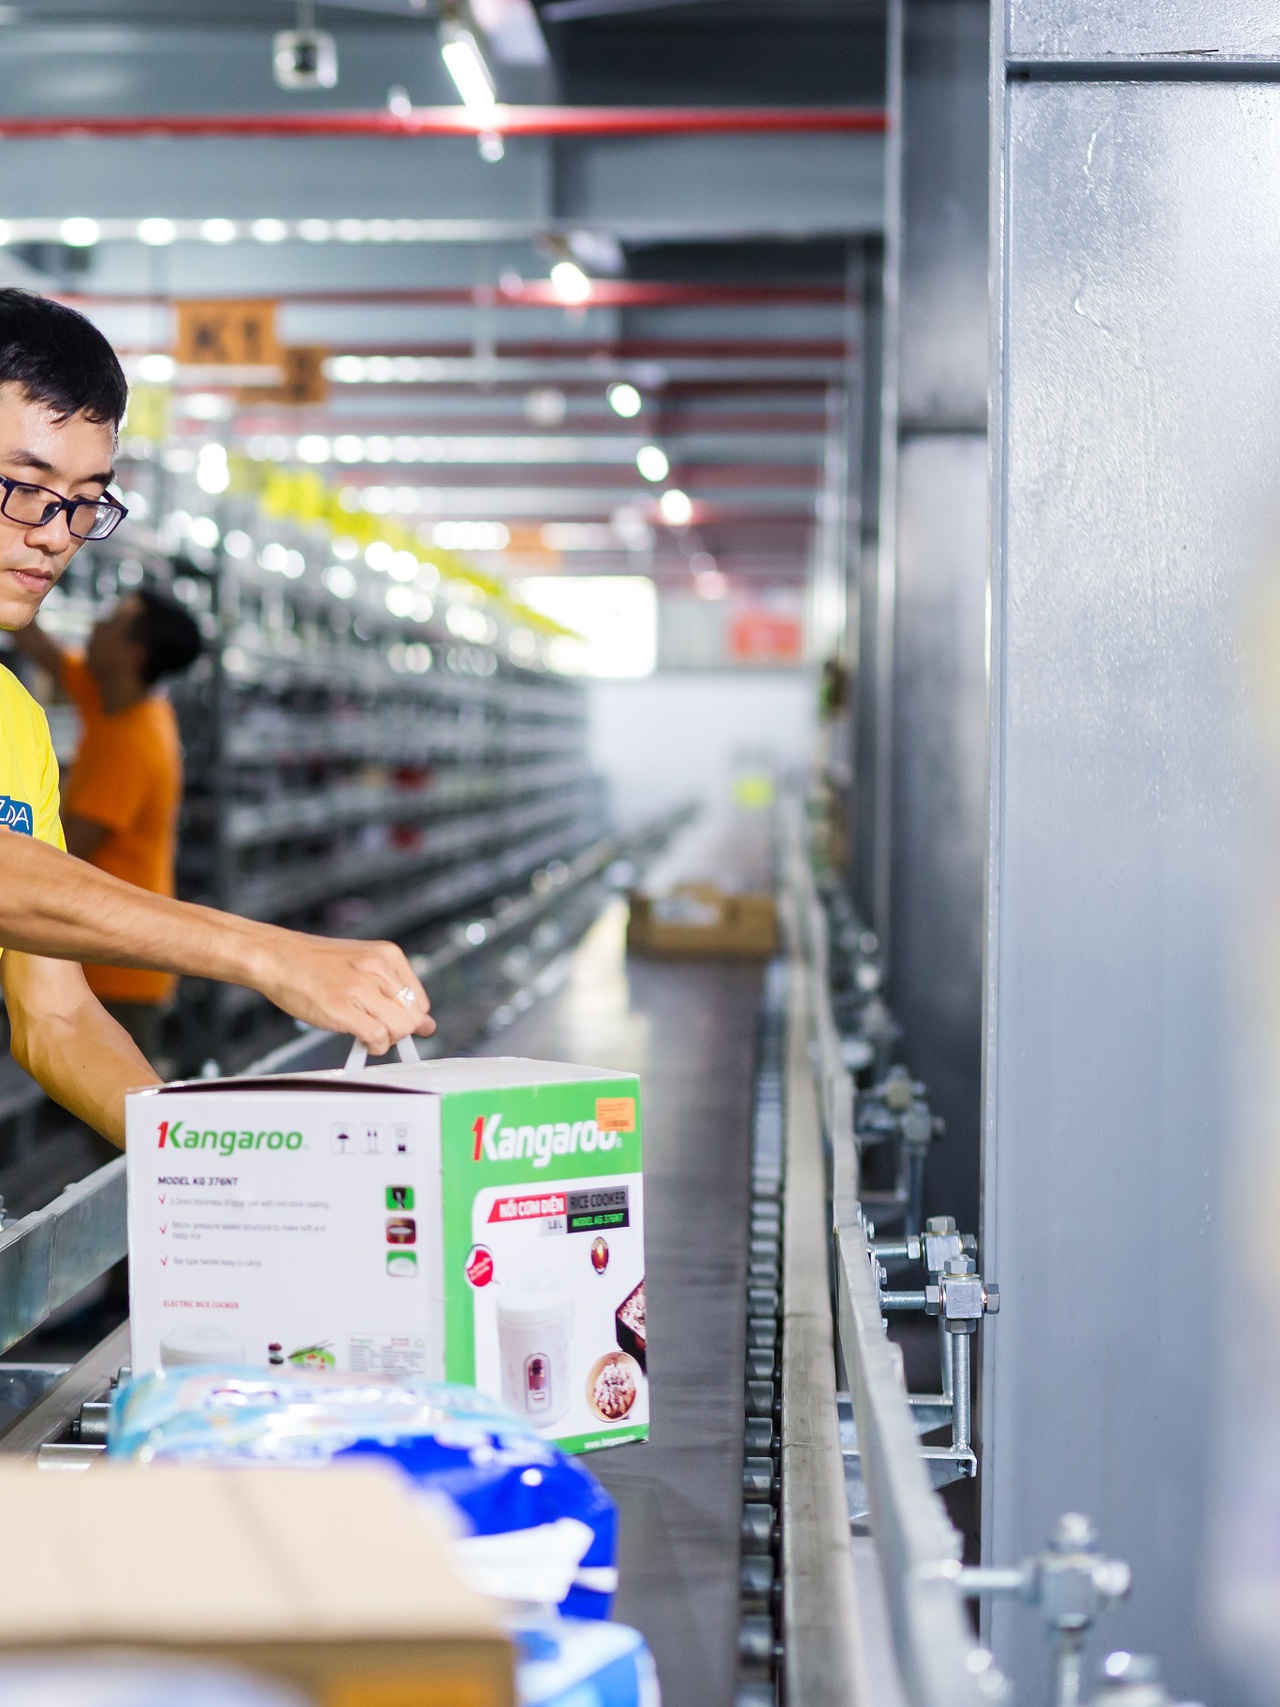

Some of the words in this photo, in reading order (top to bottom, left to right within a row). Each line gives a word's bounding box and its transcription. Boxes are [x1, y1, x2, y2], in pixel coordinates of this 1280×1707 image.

[157, 1176, 189, 1186] MODEL
[193, 1176, 205, 1186] KG
[589, 1191, 626, 1208] COOKER
